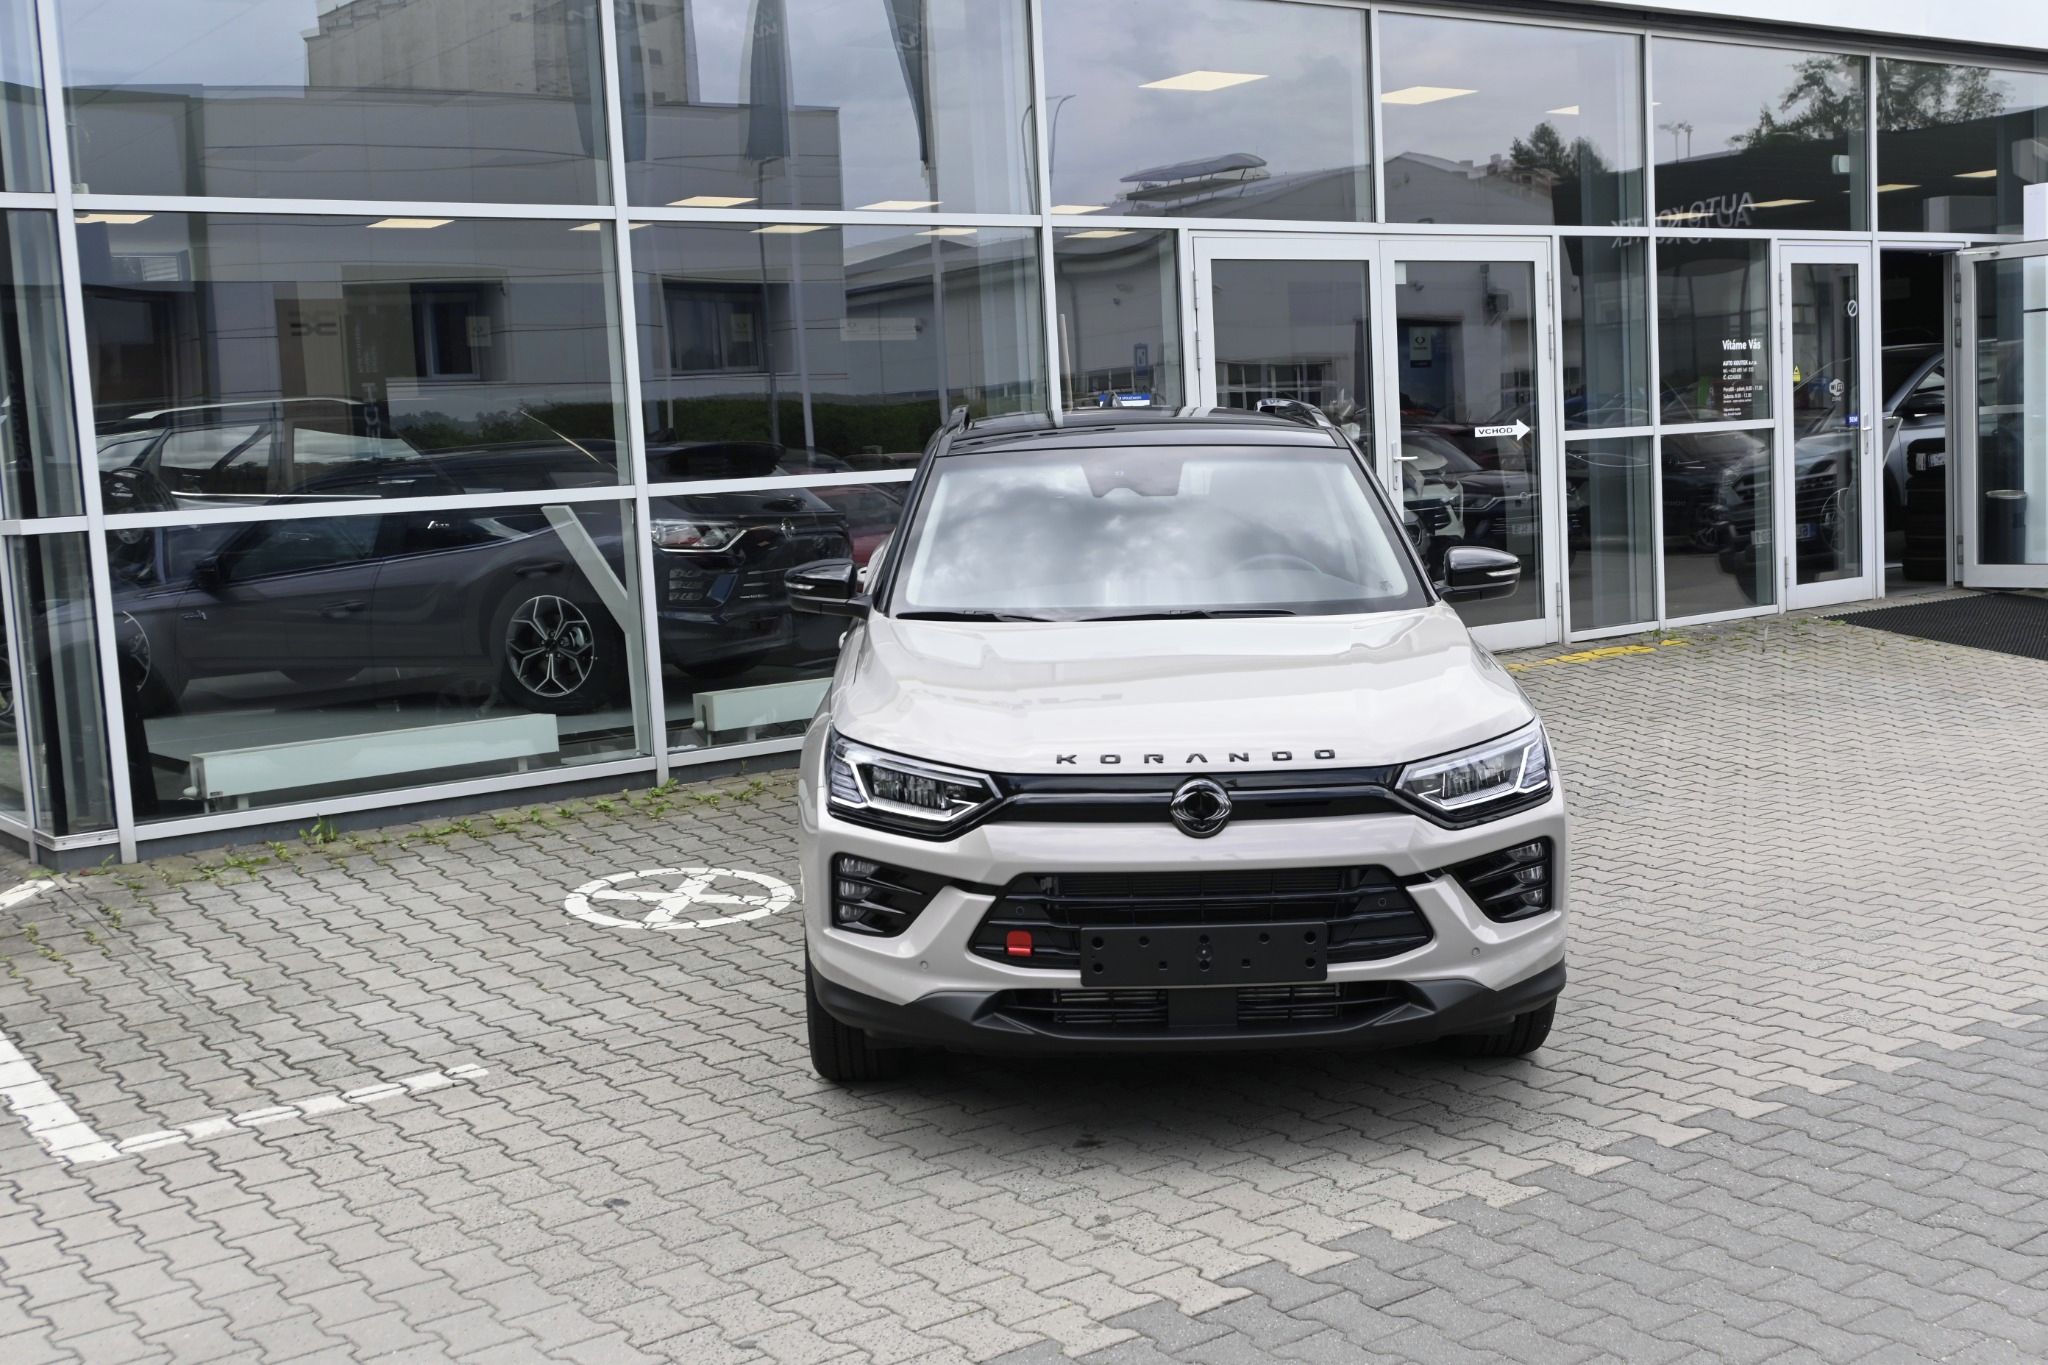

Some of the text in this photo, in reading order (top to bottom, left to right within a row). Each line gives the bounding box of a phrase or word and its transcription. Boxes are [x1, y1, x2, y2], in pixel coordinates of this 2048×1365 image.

[1722, 338, 1761, 350] Vítáme Vás
[1056, 749, 1335, 764] KORANDO
